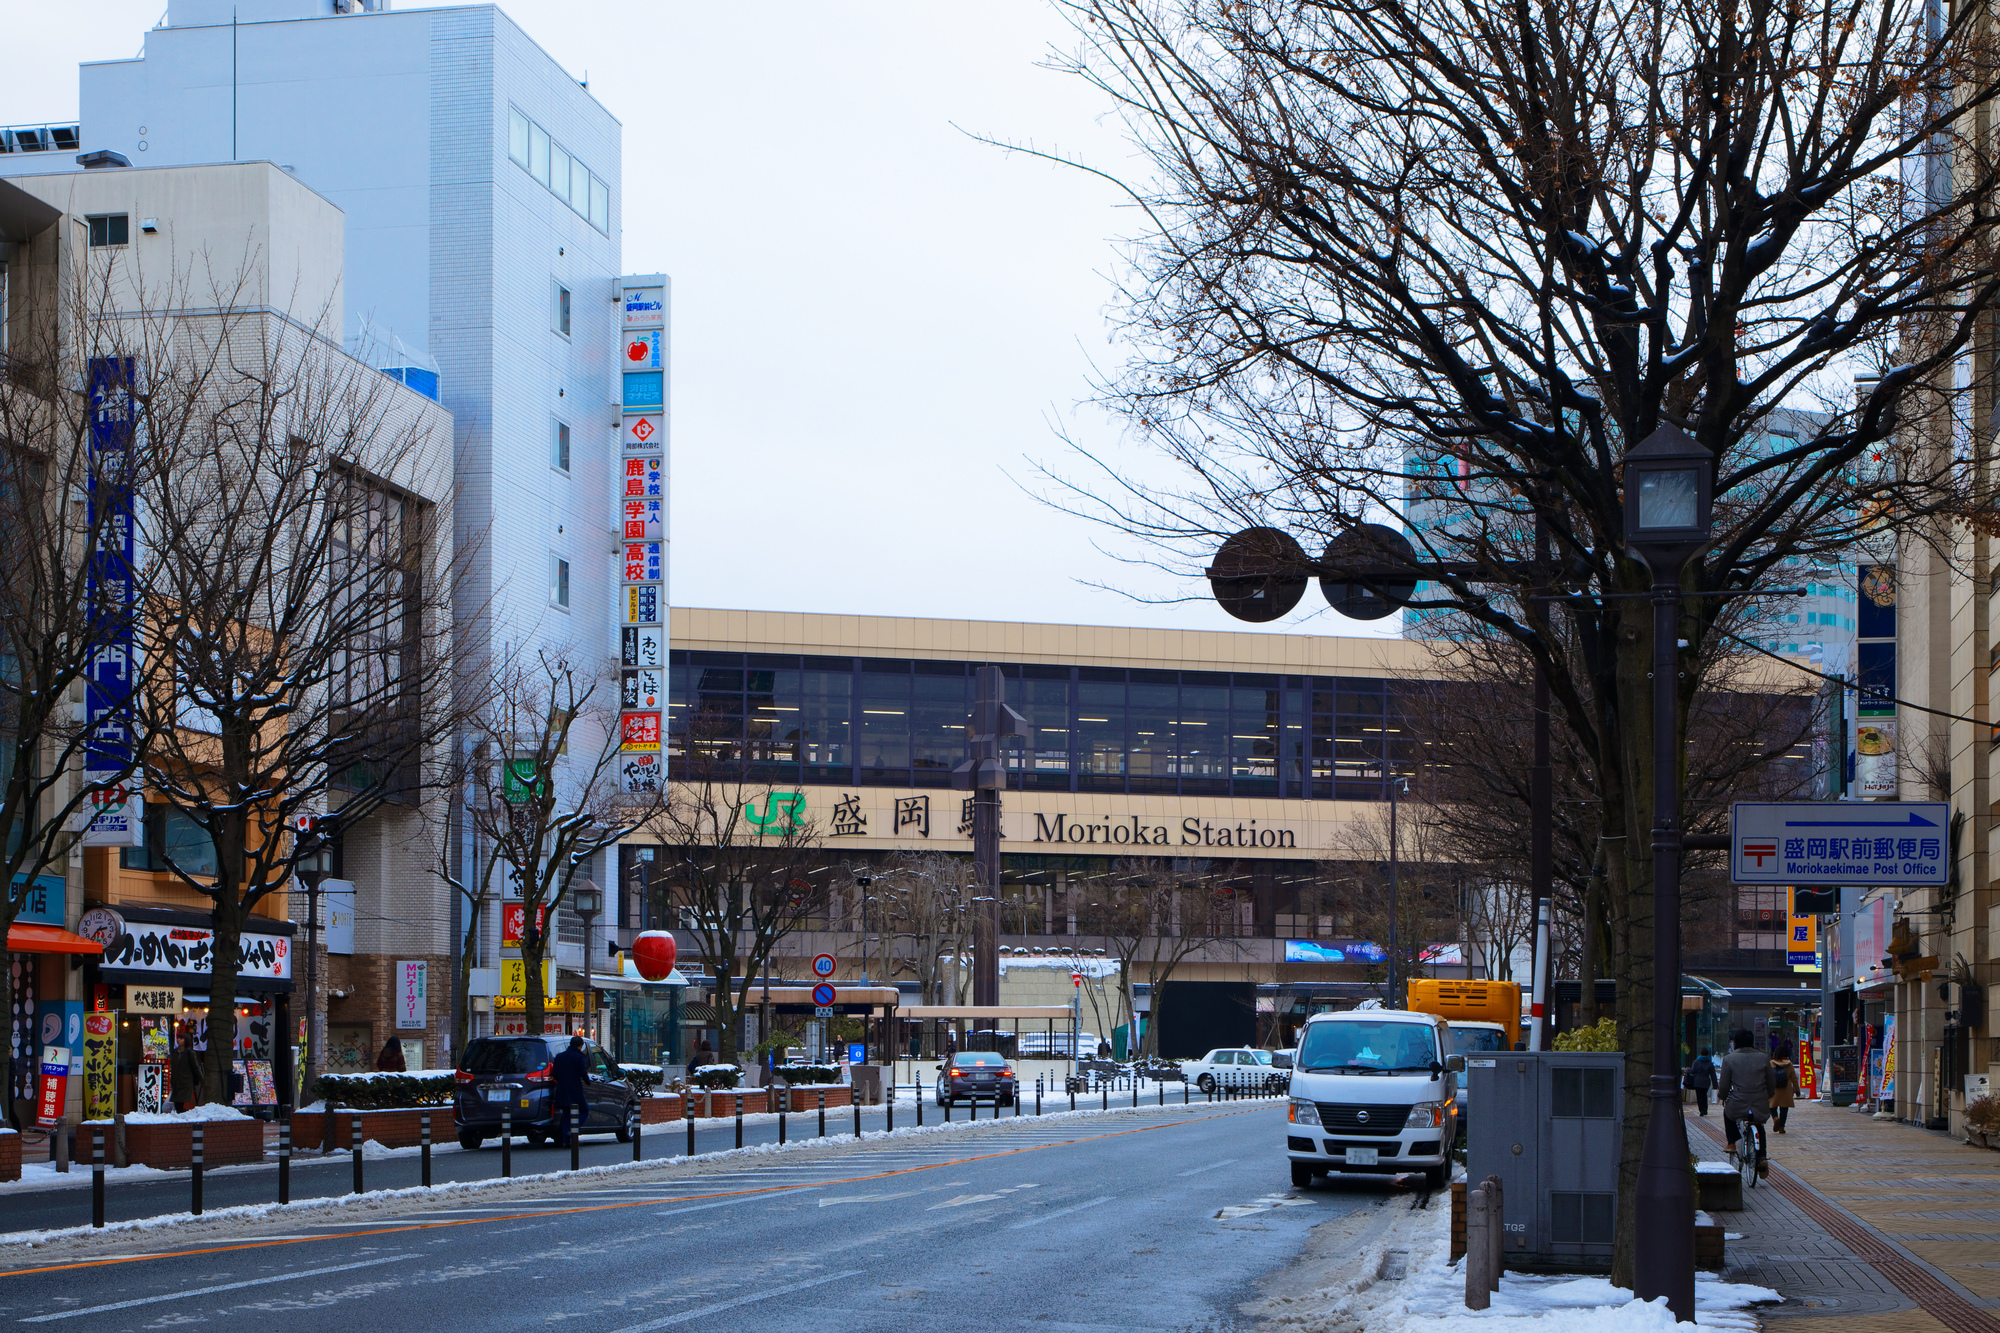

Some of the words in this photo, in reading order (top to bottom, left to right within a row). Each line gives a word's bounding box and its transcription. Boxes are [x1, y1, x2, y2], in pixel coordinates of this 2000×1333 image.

[626, 301, 662, 312] 盛岡駅前ビル
[626, 392, 660, 400] マナビス
[648, 471, 660, 524] 学校法人
[625, 458, 645, 581] 鹿島学園高校
[648, 542, 660, 580] 通信制
[745, 792, 806, 825] JR
[1033, 813, 1170, 845] Morioka
[1181, 817, 1297, 848] Station
[1784, 837, 1940, 860] 盛岡駅前郵便局
[1787, 862, 1869, 874] Moriokaekimae
[1874, 862, 1898, 874] Post
[1903, 862, 1937, 874] Office
[817, 960, 831, 971] 40
[406, 963, 417, 1018] MHナーサリー
[44, 1078, 58, 1116] 補聴器
[1504, 1223, 1525, 1232] TG2
